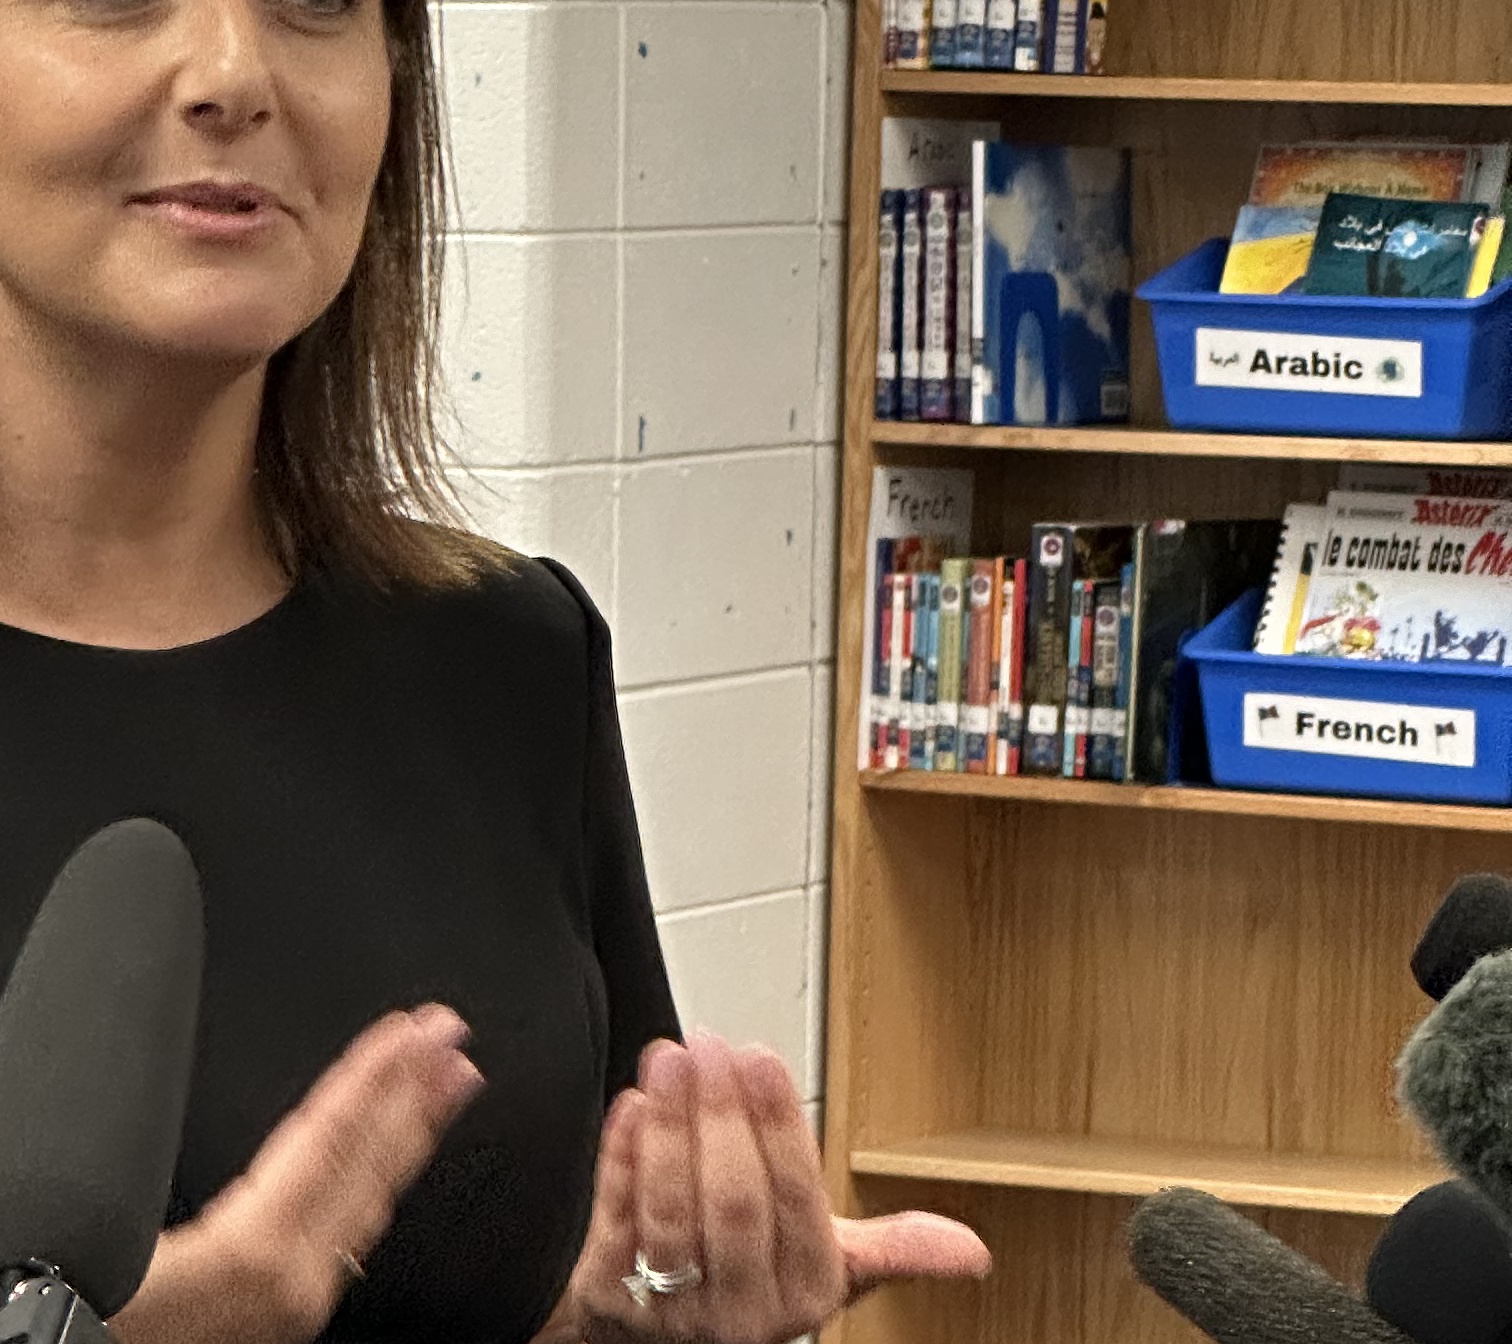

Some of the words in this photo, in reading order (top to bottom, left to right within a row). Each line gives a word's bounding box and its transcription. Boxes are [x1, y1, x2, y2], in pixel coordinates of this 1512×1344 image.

[1249, 349, 1364, 380] Arabic
[887, 478, 954, 523] French
[1345, 532, 1421, 573] combat
[1427, 536, 1466, 574] des
[1295, 711, 1419, 747] French
